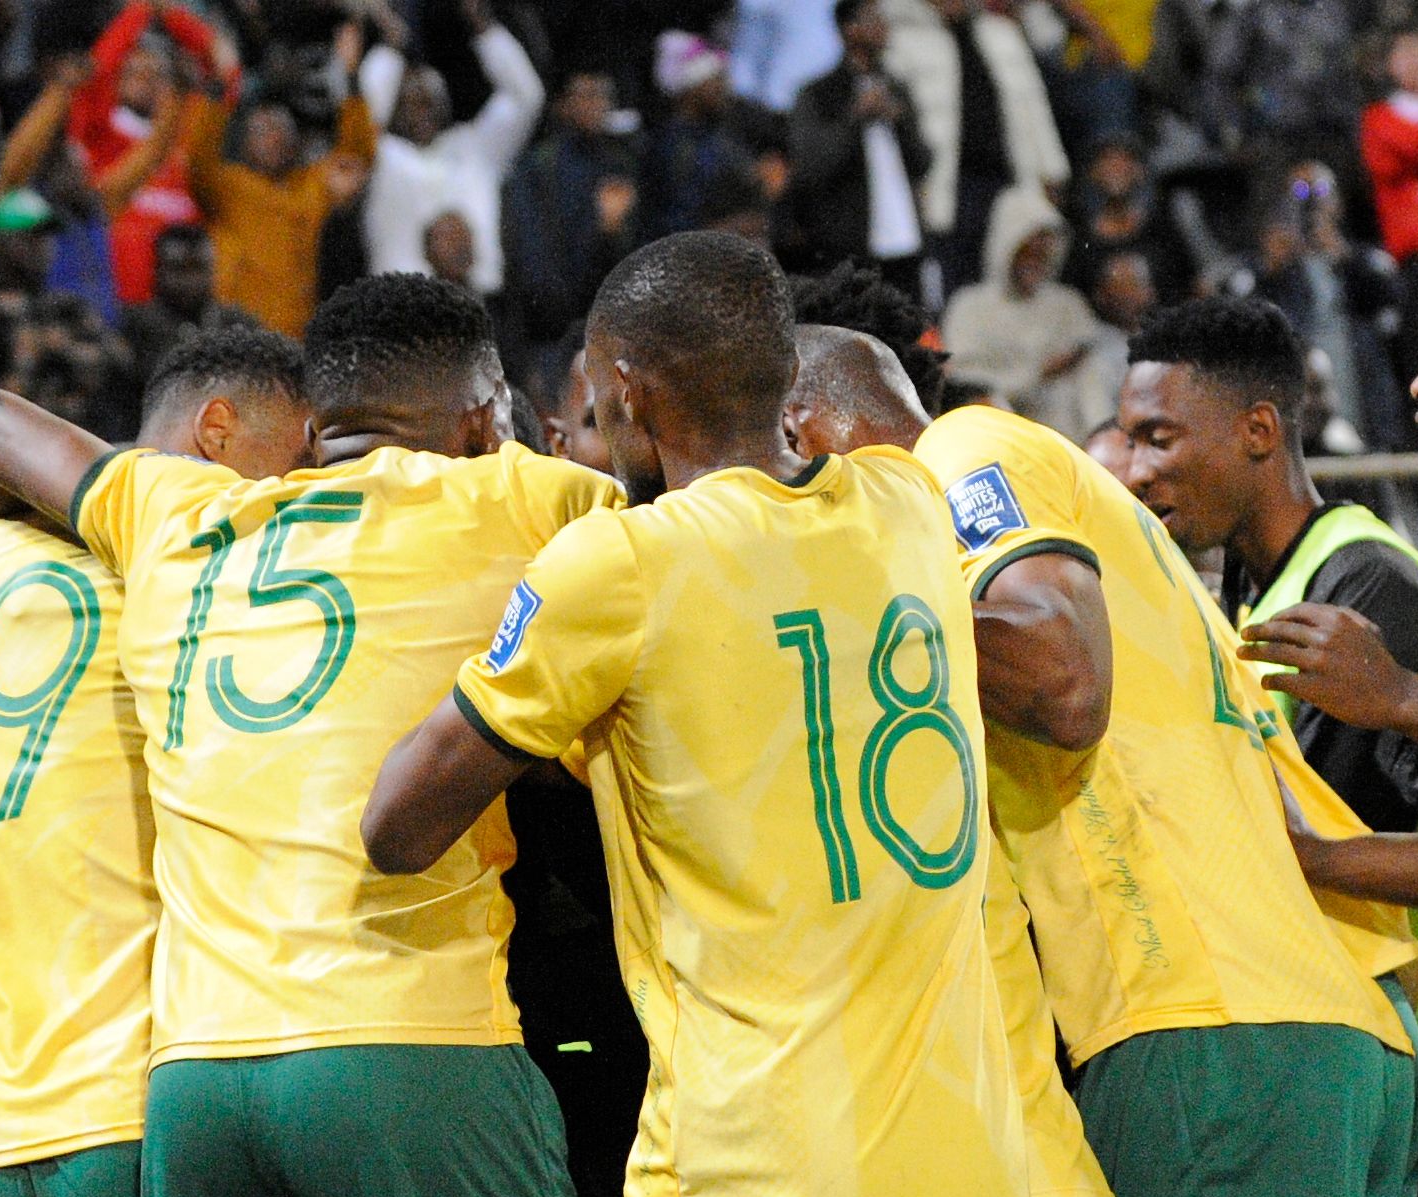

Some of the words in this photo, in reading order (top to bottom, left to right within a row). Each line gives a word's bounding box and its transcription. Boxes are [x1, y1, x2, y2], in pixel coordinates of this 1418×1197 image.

[163, 490, 364, 752] 15
[954, 487, 998, 517] UNITES
[772, 593, 979, 905] 18
